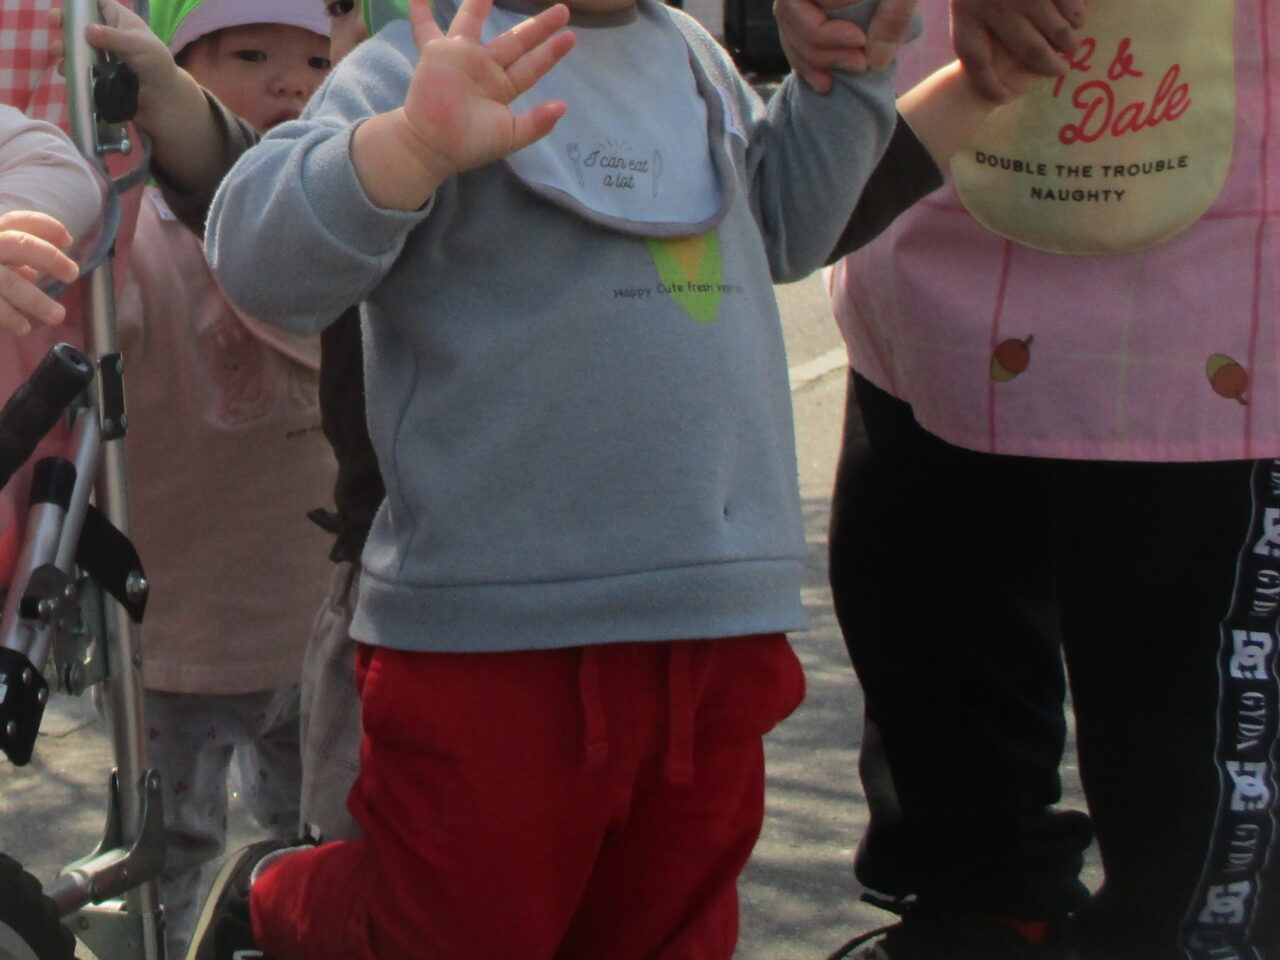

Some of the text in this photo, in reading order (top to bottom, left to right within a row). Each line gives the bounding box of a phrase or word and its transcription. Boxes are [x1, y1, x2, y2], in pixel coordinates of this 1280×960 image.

[1058, 63, 1192, 145] Dale
[600, 155, 626, 169] can
[628, 159, 648, 173] eat
[975, 151, 1189, 177] DOUBLE THE TROUBLE
[615, 172, 635, 189] lot
[1030, 187, 1125, 202] NAUGHTY
[613, 286, 651, 301] Happy
[1236, 691, 1266, 751] GYDA
